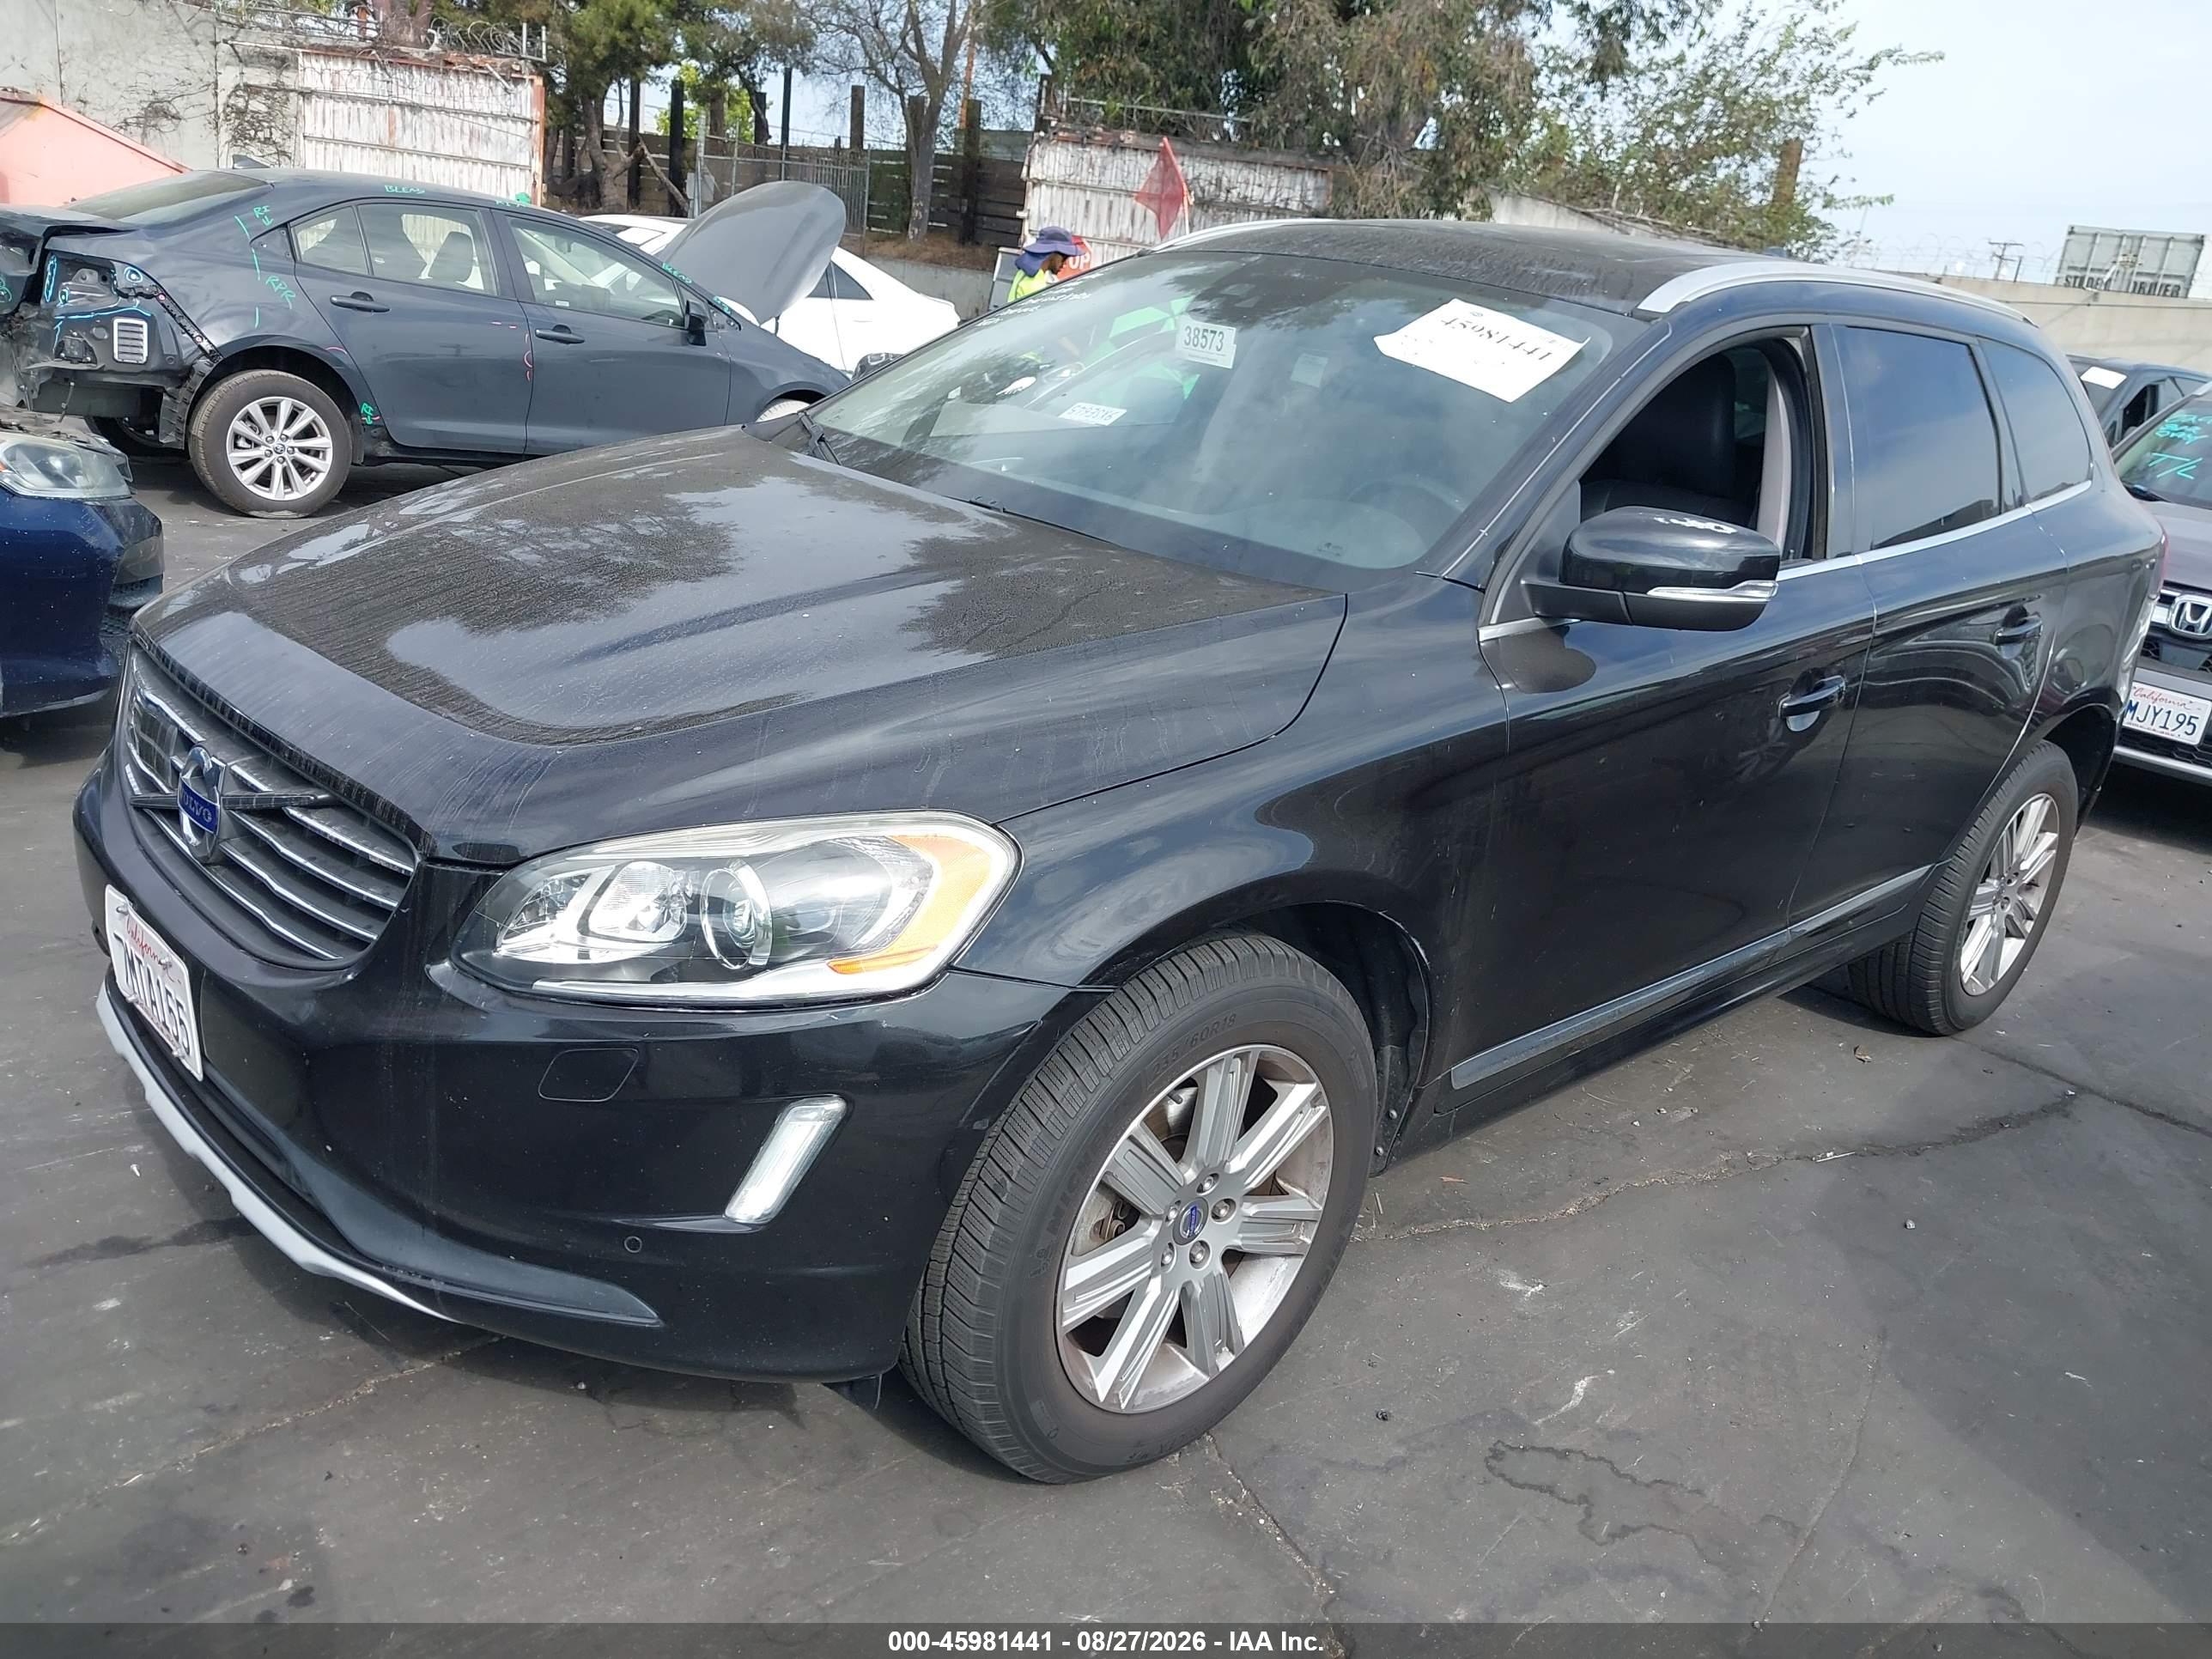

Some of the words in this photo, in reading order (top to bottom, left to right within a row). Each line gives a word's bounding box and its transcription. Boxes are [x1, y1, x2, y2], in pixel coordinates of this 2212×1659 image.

[1183, 325, 1225, 352] 38573
[2133, 687, 2191, 711] California
[2124, 699, 2199, 737] MJY195
